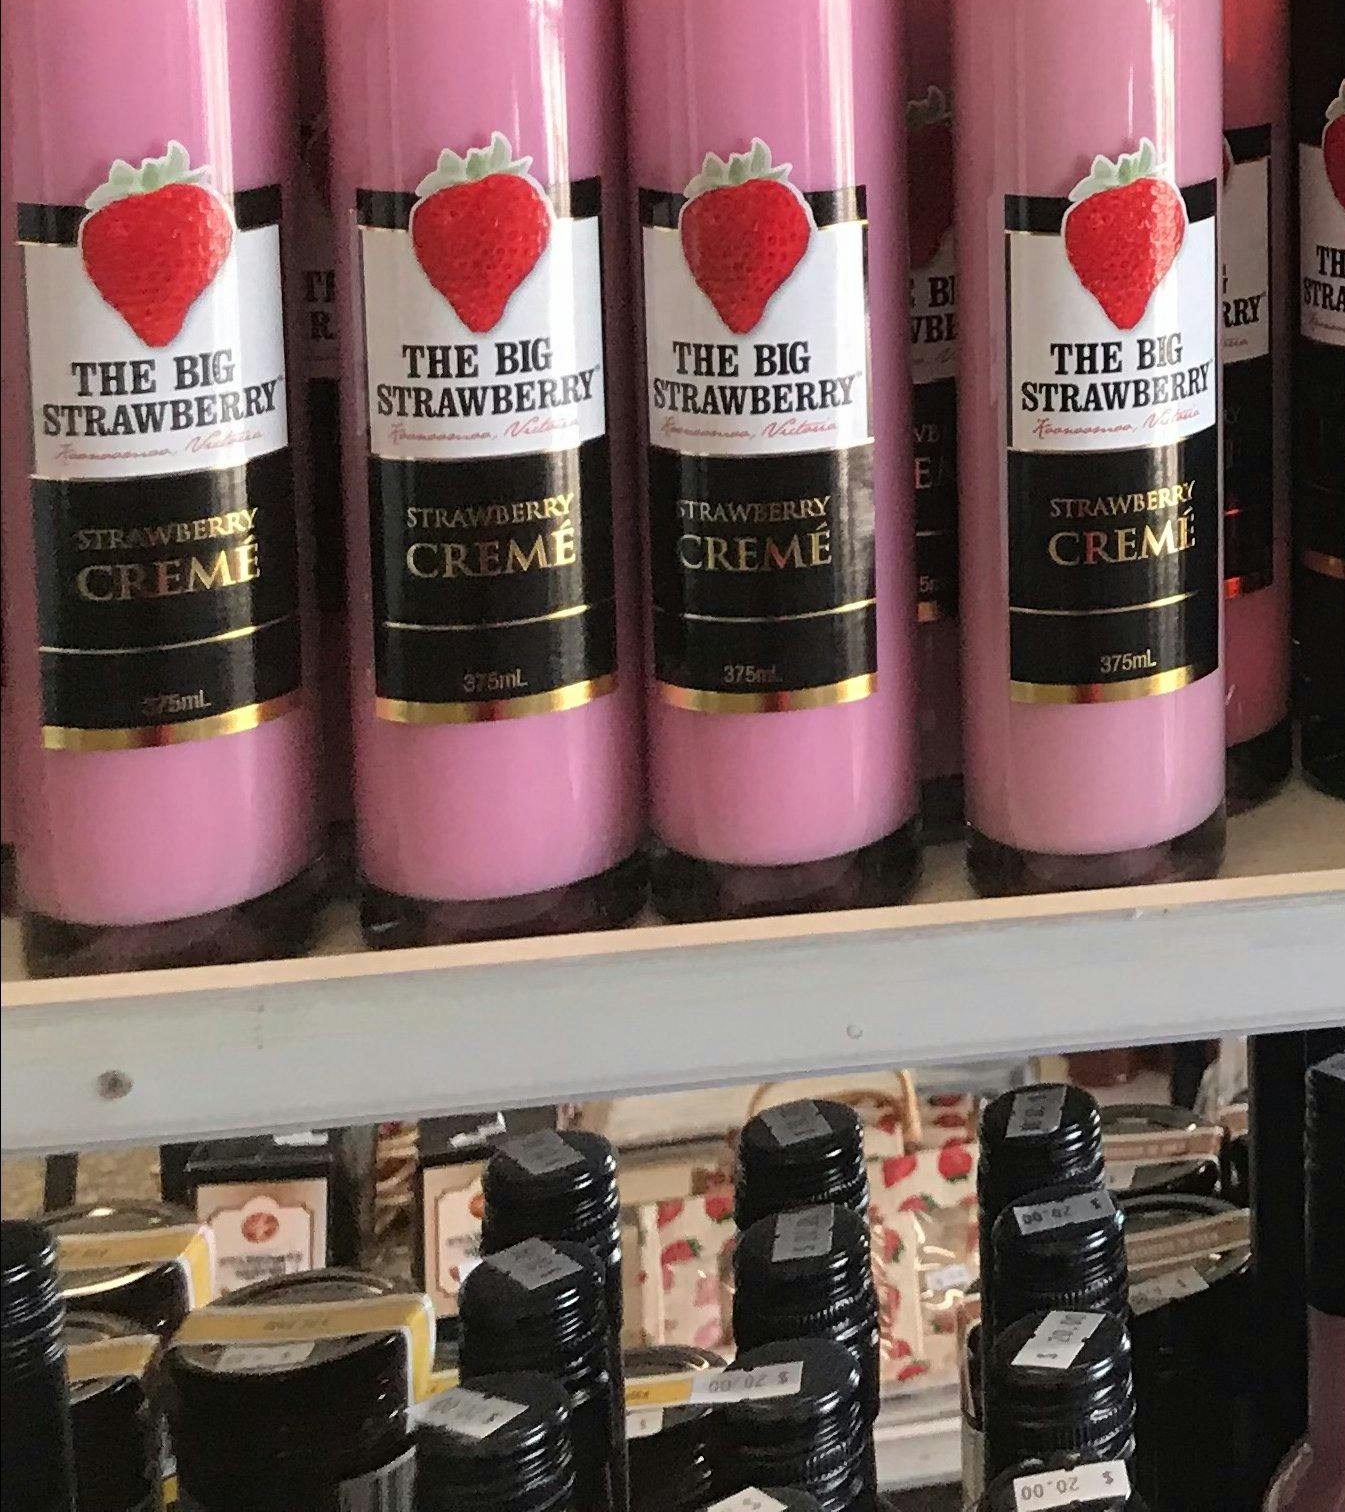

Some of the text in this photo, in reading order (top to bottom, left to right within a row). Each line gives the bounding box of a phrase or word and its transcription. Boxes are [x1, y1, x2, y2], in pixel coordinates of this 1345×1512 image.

[71, 348, 236, 397] THE BIG
[402, 337, 554, 380] THE BIG
[673, 340, 813, 378] THE BIG
[1050, 331, 1184, 376] THE BIG
[42, 377, 281, 438] STRAWBERRY
[376, 367, 598, 419] STRAWBERRY
[652, 373, 858, 417] STRAWBERRY
[1020, 363, 1211, 414] STRAWBERRY
[406, 492, 575, 530] STRAWBERRY
[675, 495, 833, 525] STRAWBERRY
[1048, 478, 1197, 520] STRAWBERRY
[75, 507, 259, 552] STRAWBERRY
[406, 519, 577, 580] CREMÉ
[677, 521, 833, 572] CREMÉ
[1047, 506, 1197, 568] CREMÉ
[75, 534, 261, 603] CREMÉ
[462, 667, 530, 694] 375mL
[1099, 649, 1158, 674] 375mL
[1019, 1476, 1081, 1501] 20.00
